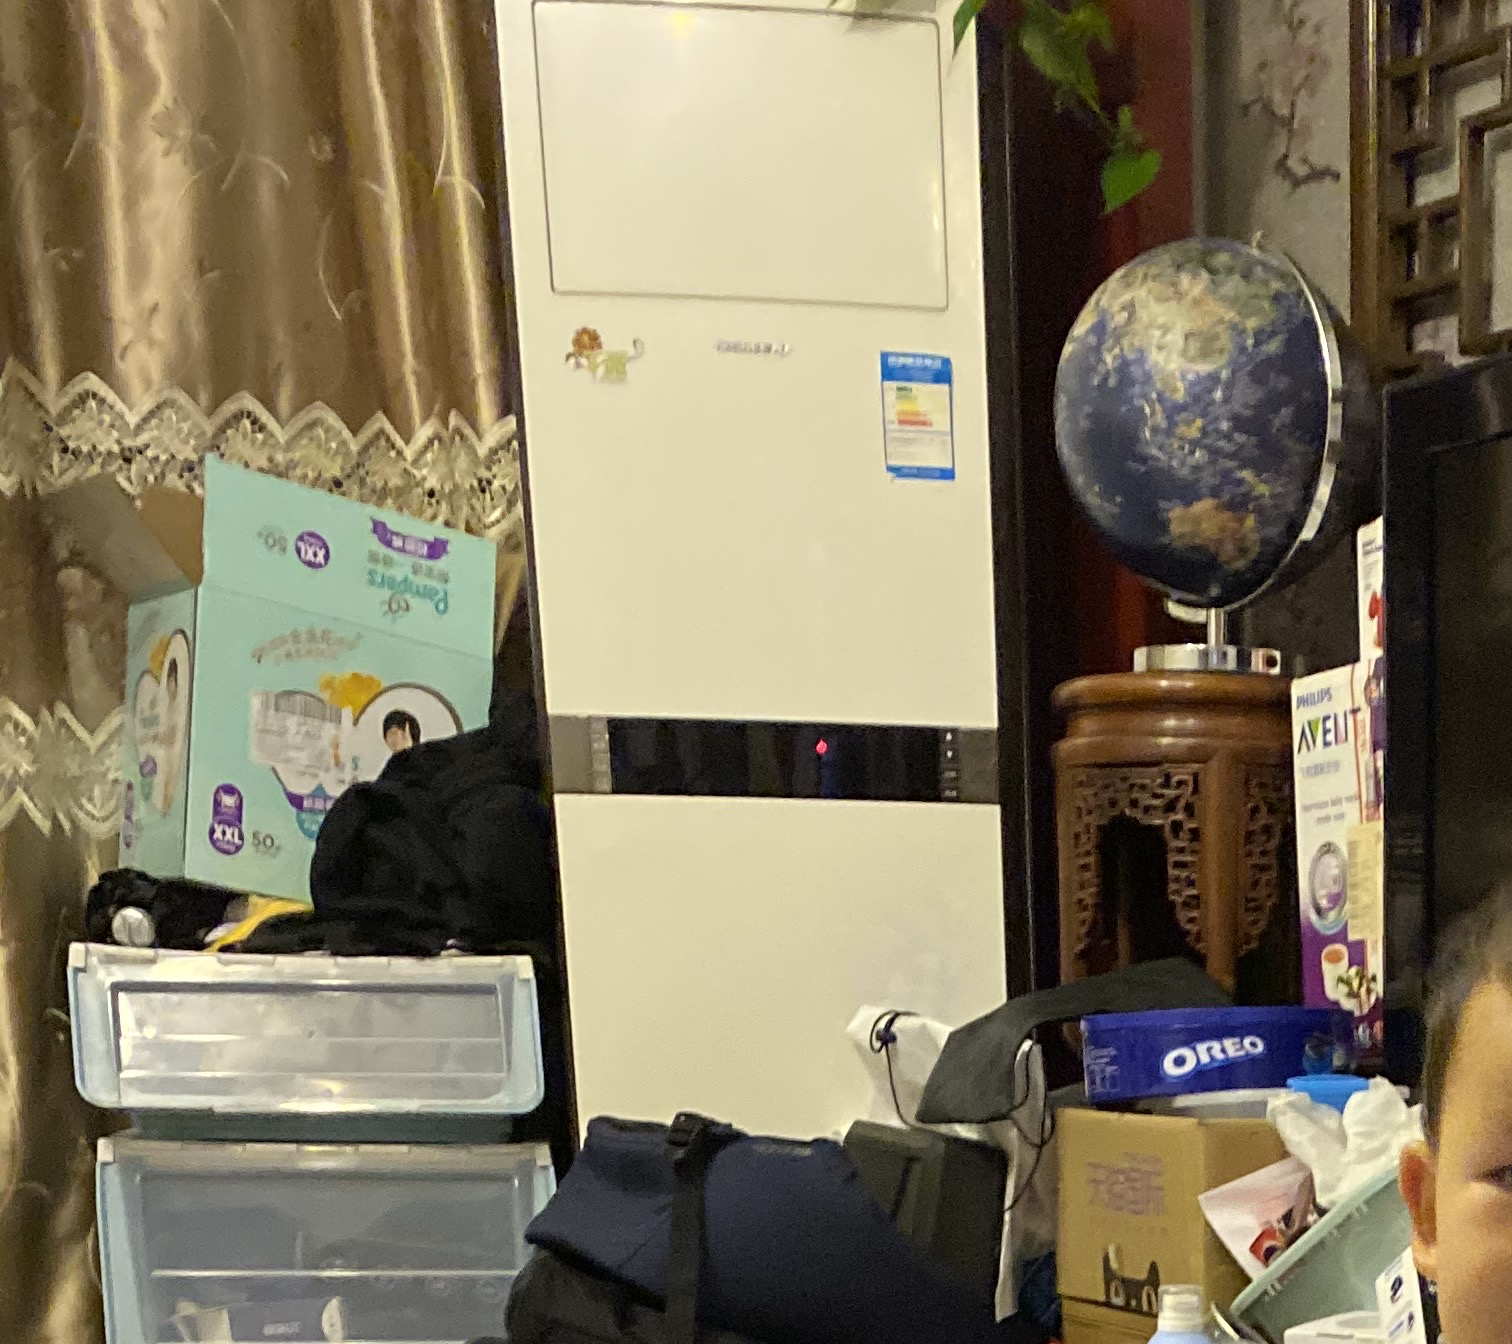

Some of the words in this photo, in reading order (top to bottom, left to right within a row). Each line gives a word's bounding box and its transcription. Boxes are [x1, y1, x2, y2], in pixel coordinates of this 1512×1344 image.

[367, 567, 450, 616] Pampers
[1296, 686, 1333, 711] PHILIPS
[1297, 707, 1362, 755] AVENT
[213, 822, 243, 846] XXL
[1162, 1035, 1266, 1077] OREO
